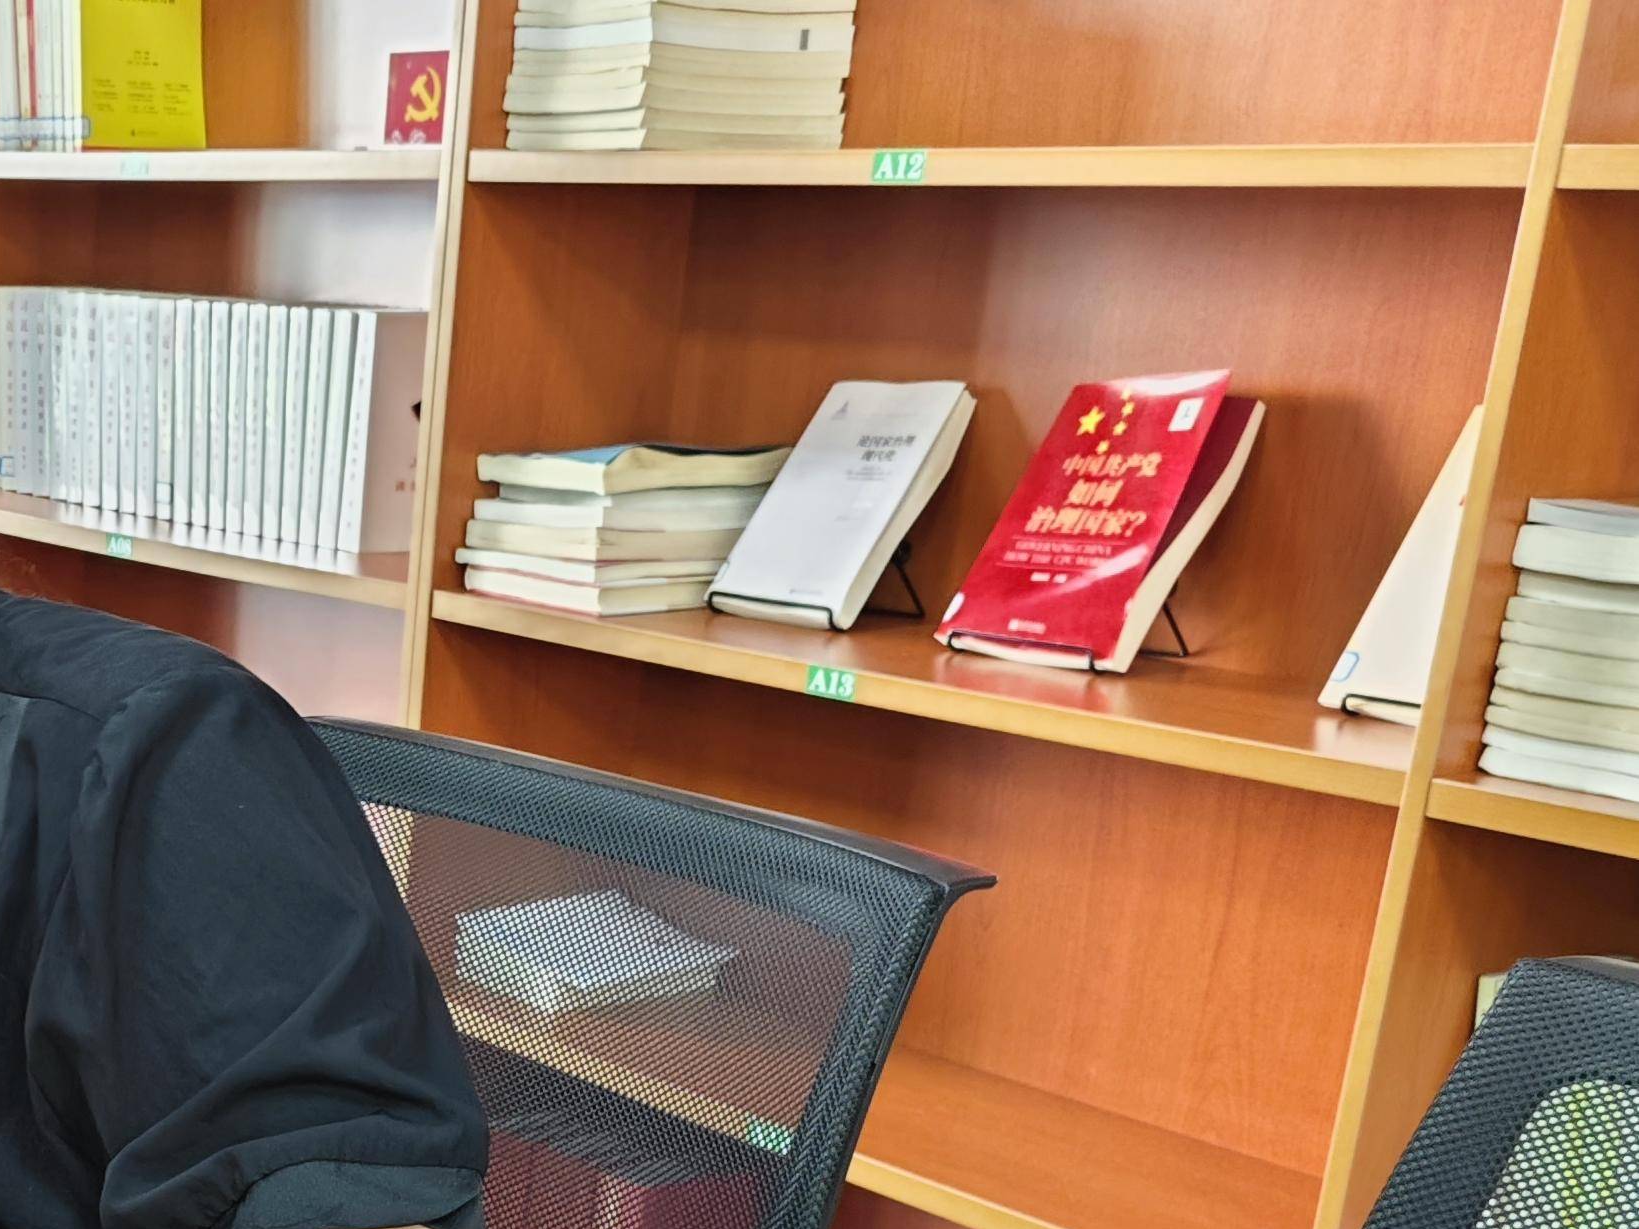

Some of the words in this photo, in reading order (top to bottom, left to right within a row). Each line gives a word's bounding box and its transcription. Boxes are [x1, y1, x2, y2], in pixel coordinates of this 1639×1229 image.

[874, 153, 925, 180] A12
[1063, 480, 1124, 507] 如何
[808, 669, 855, 698] A13
